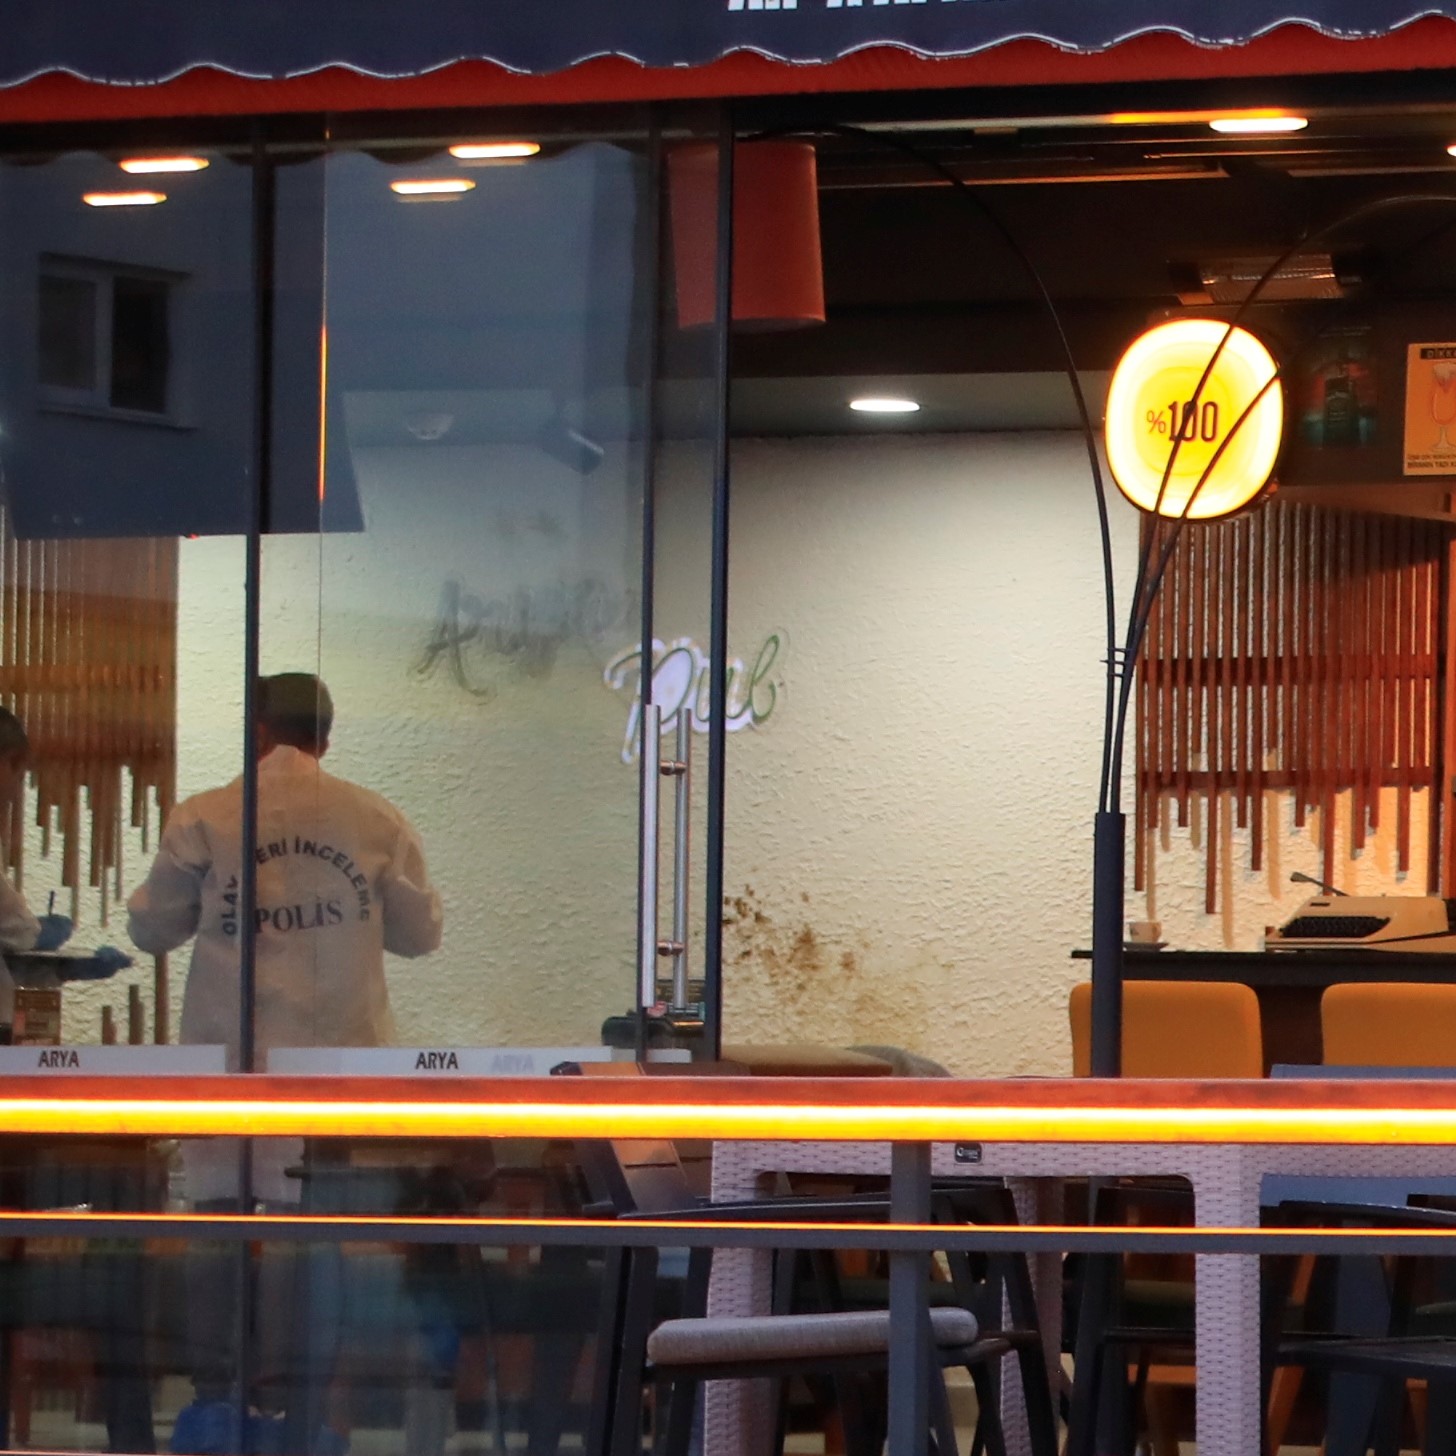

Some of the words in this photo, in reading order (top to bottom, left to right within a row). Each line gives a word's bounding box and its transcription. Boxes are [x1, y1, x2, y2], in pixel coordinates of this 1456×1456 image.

[1146, 400, 1218, 442] %100
[255, 837, 288, 865] ERİ
[253, 894, 344, 934] POLİS
[38, 1050, 80, 1068] ARYA
[415, 1051, 459, 1070] ARYA
